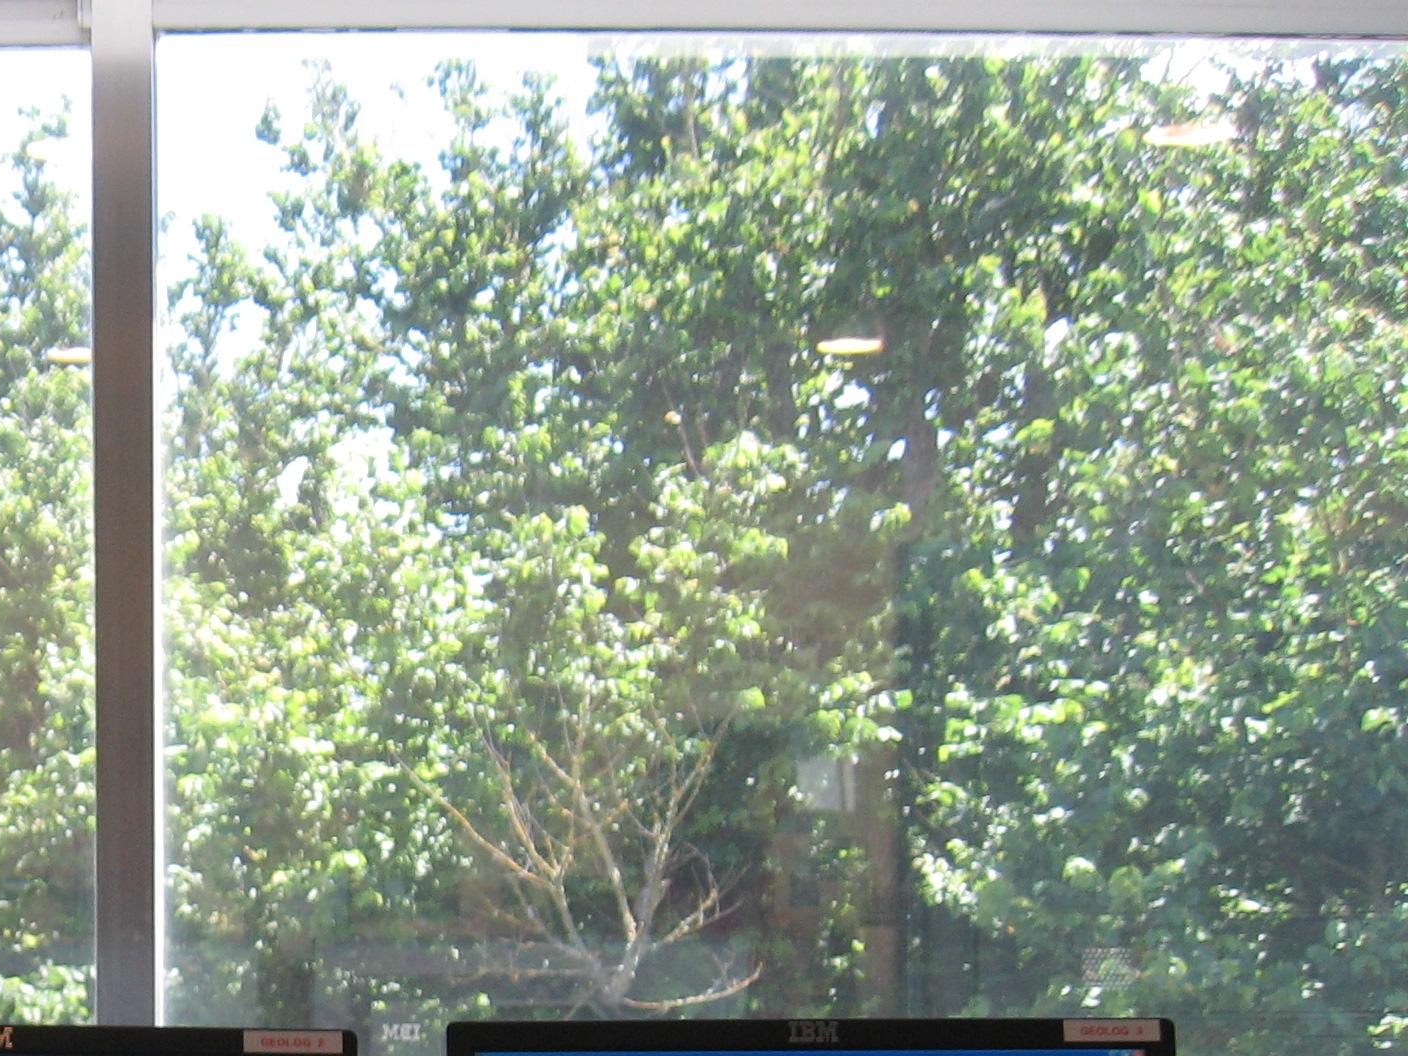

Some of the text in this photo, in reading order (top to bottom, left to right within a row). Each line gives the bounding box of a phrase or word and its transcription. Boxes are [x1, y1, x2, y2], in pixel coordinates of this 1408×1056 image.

[788, 1020, 839, 1043] IBM
[1080, 1025, 1129, 1036] GEOLOG
[260, 1036, 311, 1048] GEOLOG
